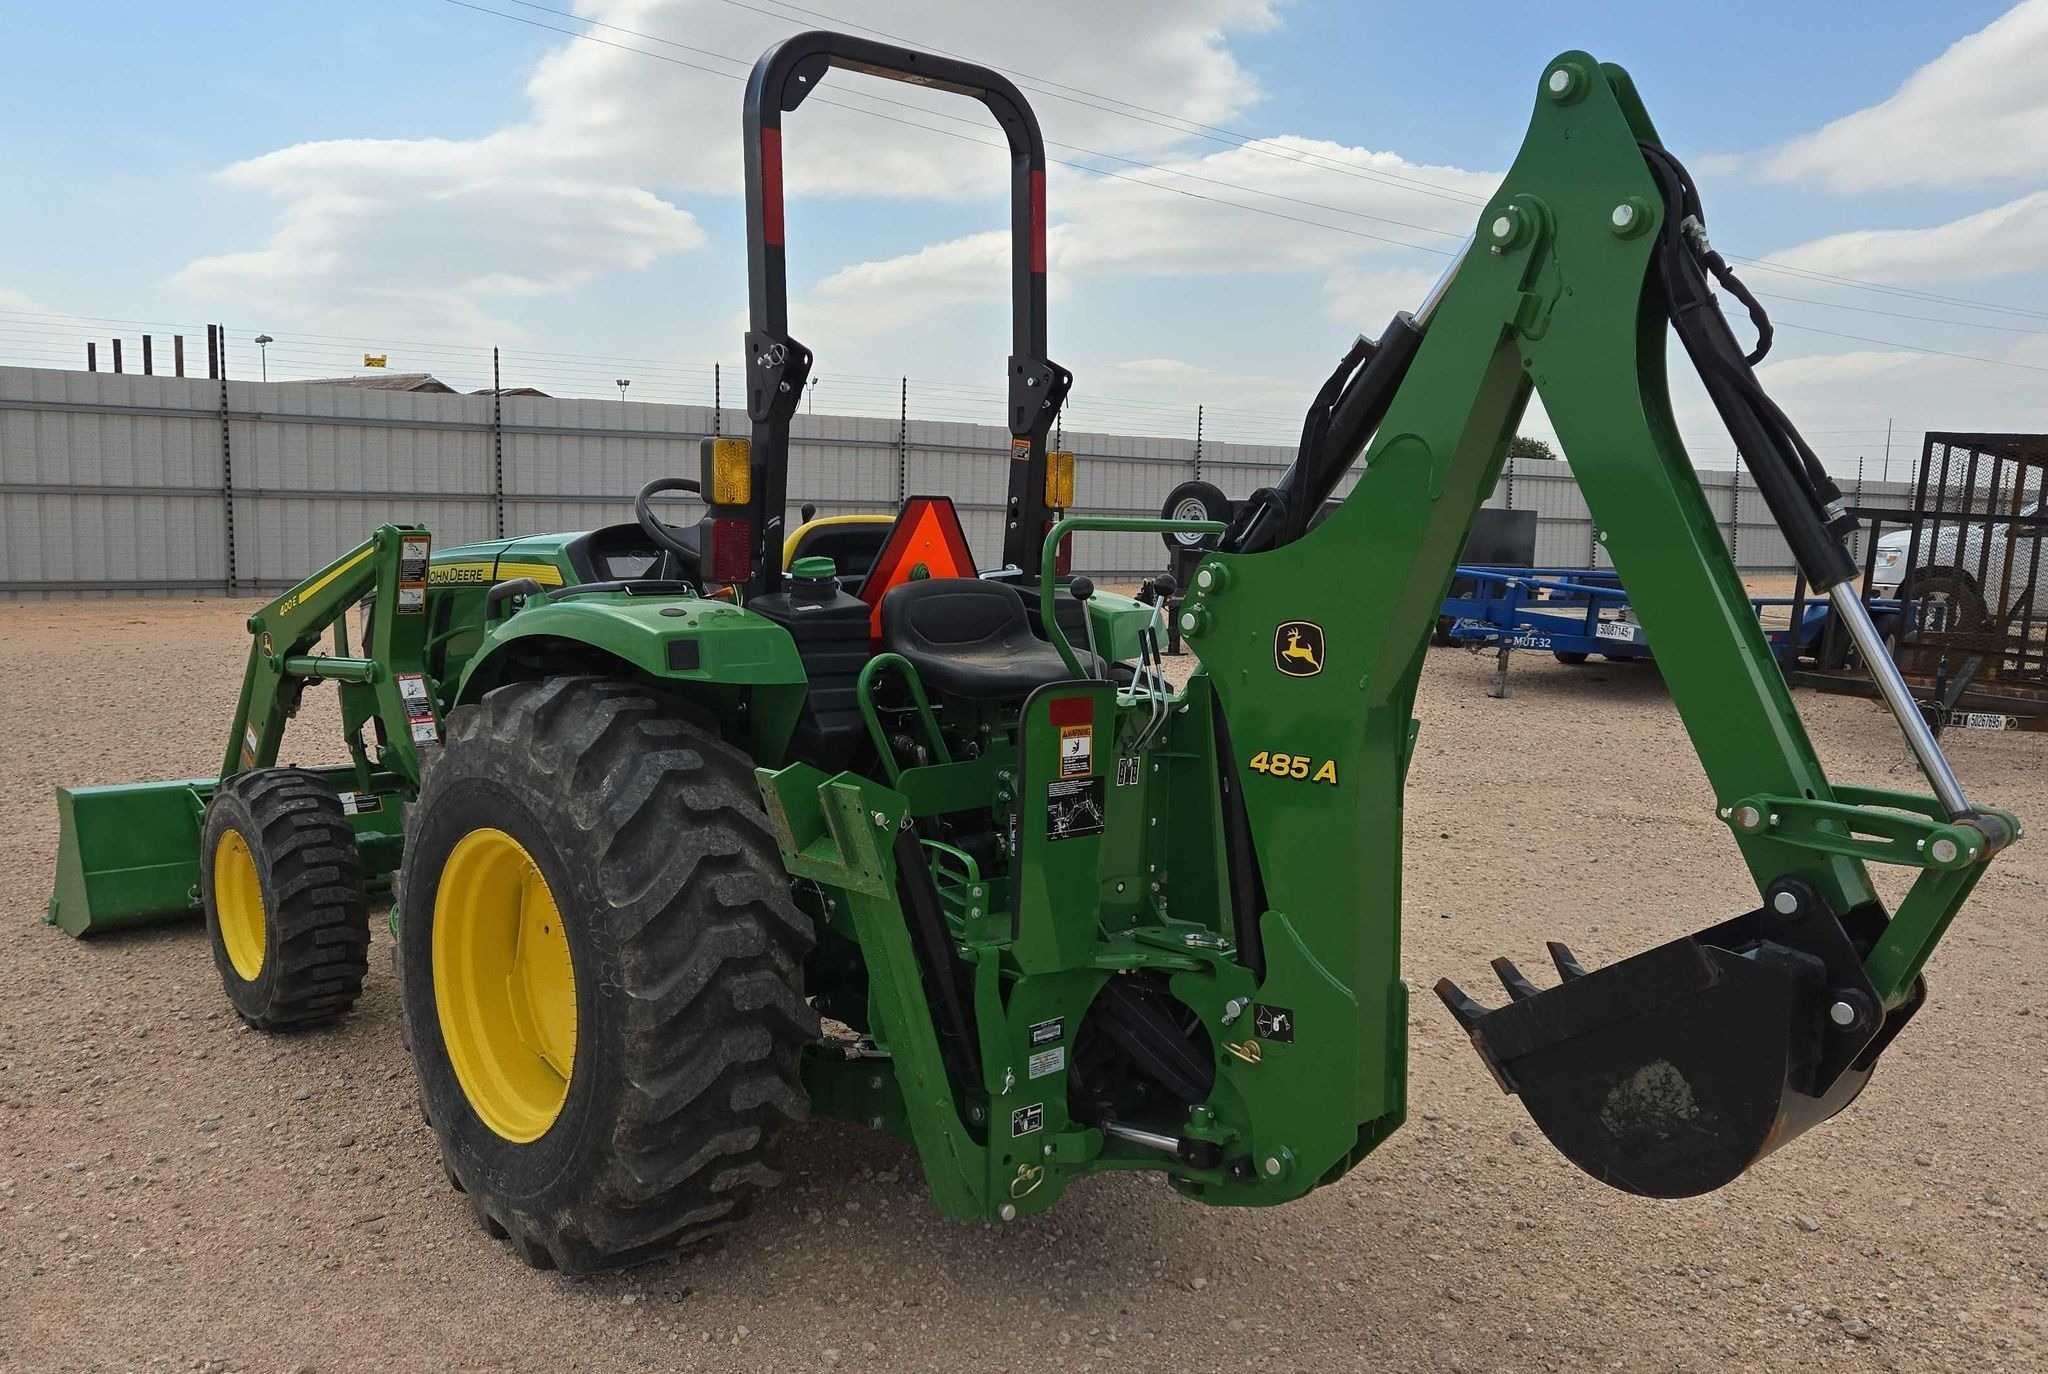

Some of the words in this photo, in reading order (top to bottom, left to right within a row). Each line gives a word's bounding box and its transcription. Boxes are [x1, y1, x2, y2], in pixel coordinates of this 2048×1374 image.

[428, 569, 450, 583] OHN
[450, 567, 484, 581] DEERE
[1512, 636, 1552, 648] MUT-32
[1067, 728, 1091, 737] WARNING
